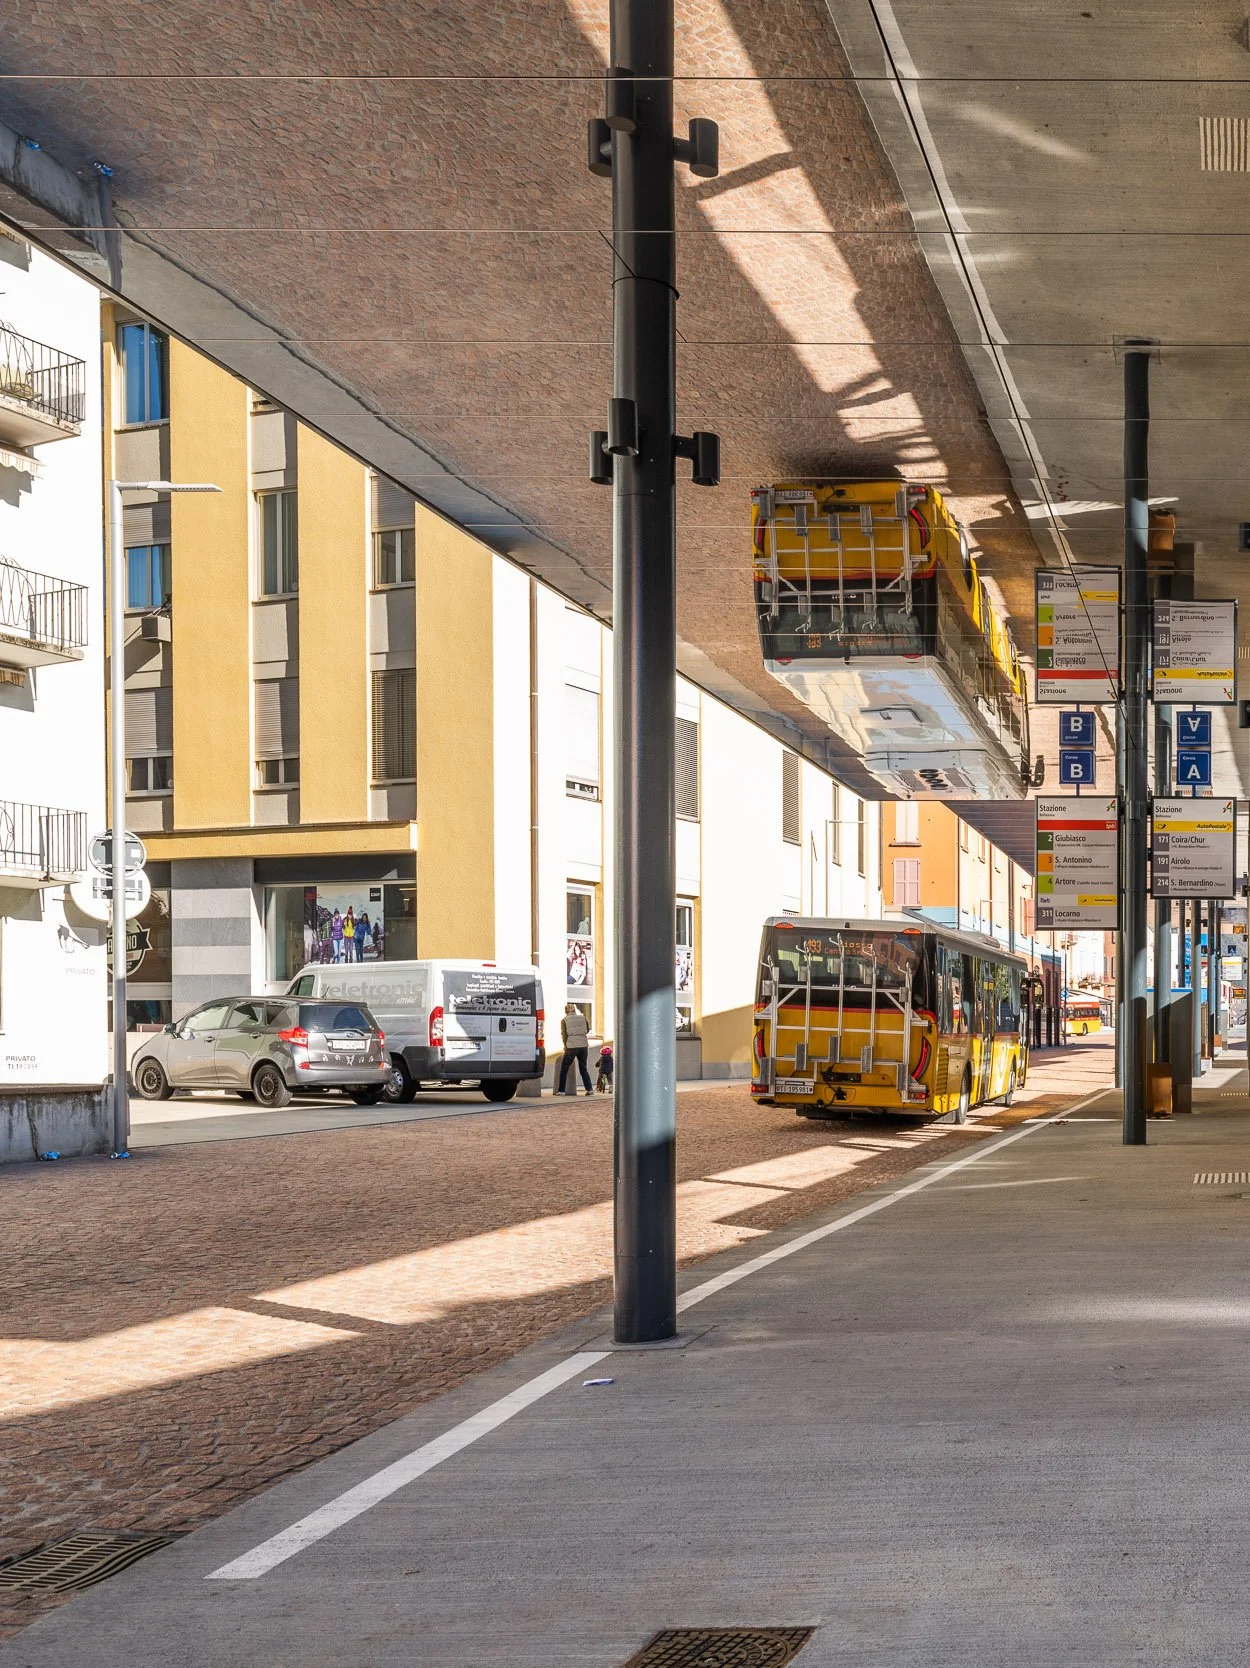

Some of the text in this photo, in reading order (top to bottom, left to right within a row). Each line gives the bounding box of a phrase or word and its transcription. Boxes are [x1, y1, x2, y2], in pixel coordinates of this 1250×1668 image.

[1070, 764, 1083, 778] B
[1187, 764, 1201, 779] A
[1178, 878, 1214, 887] Bernardino
[448, 994, 531, 1006] teletronic
